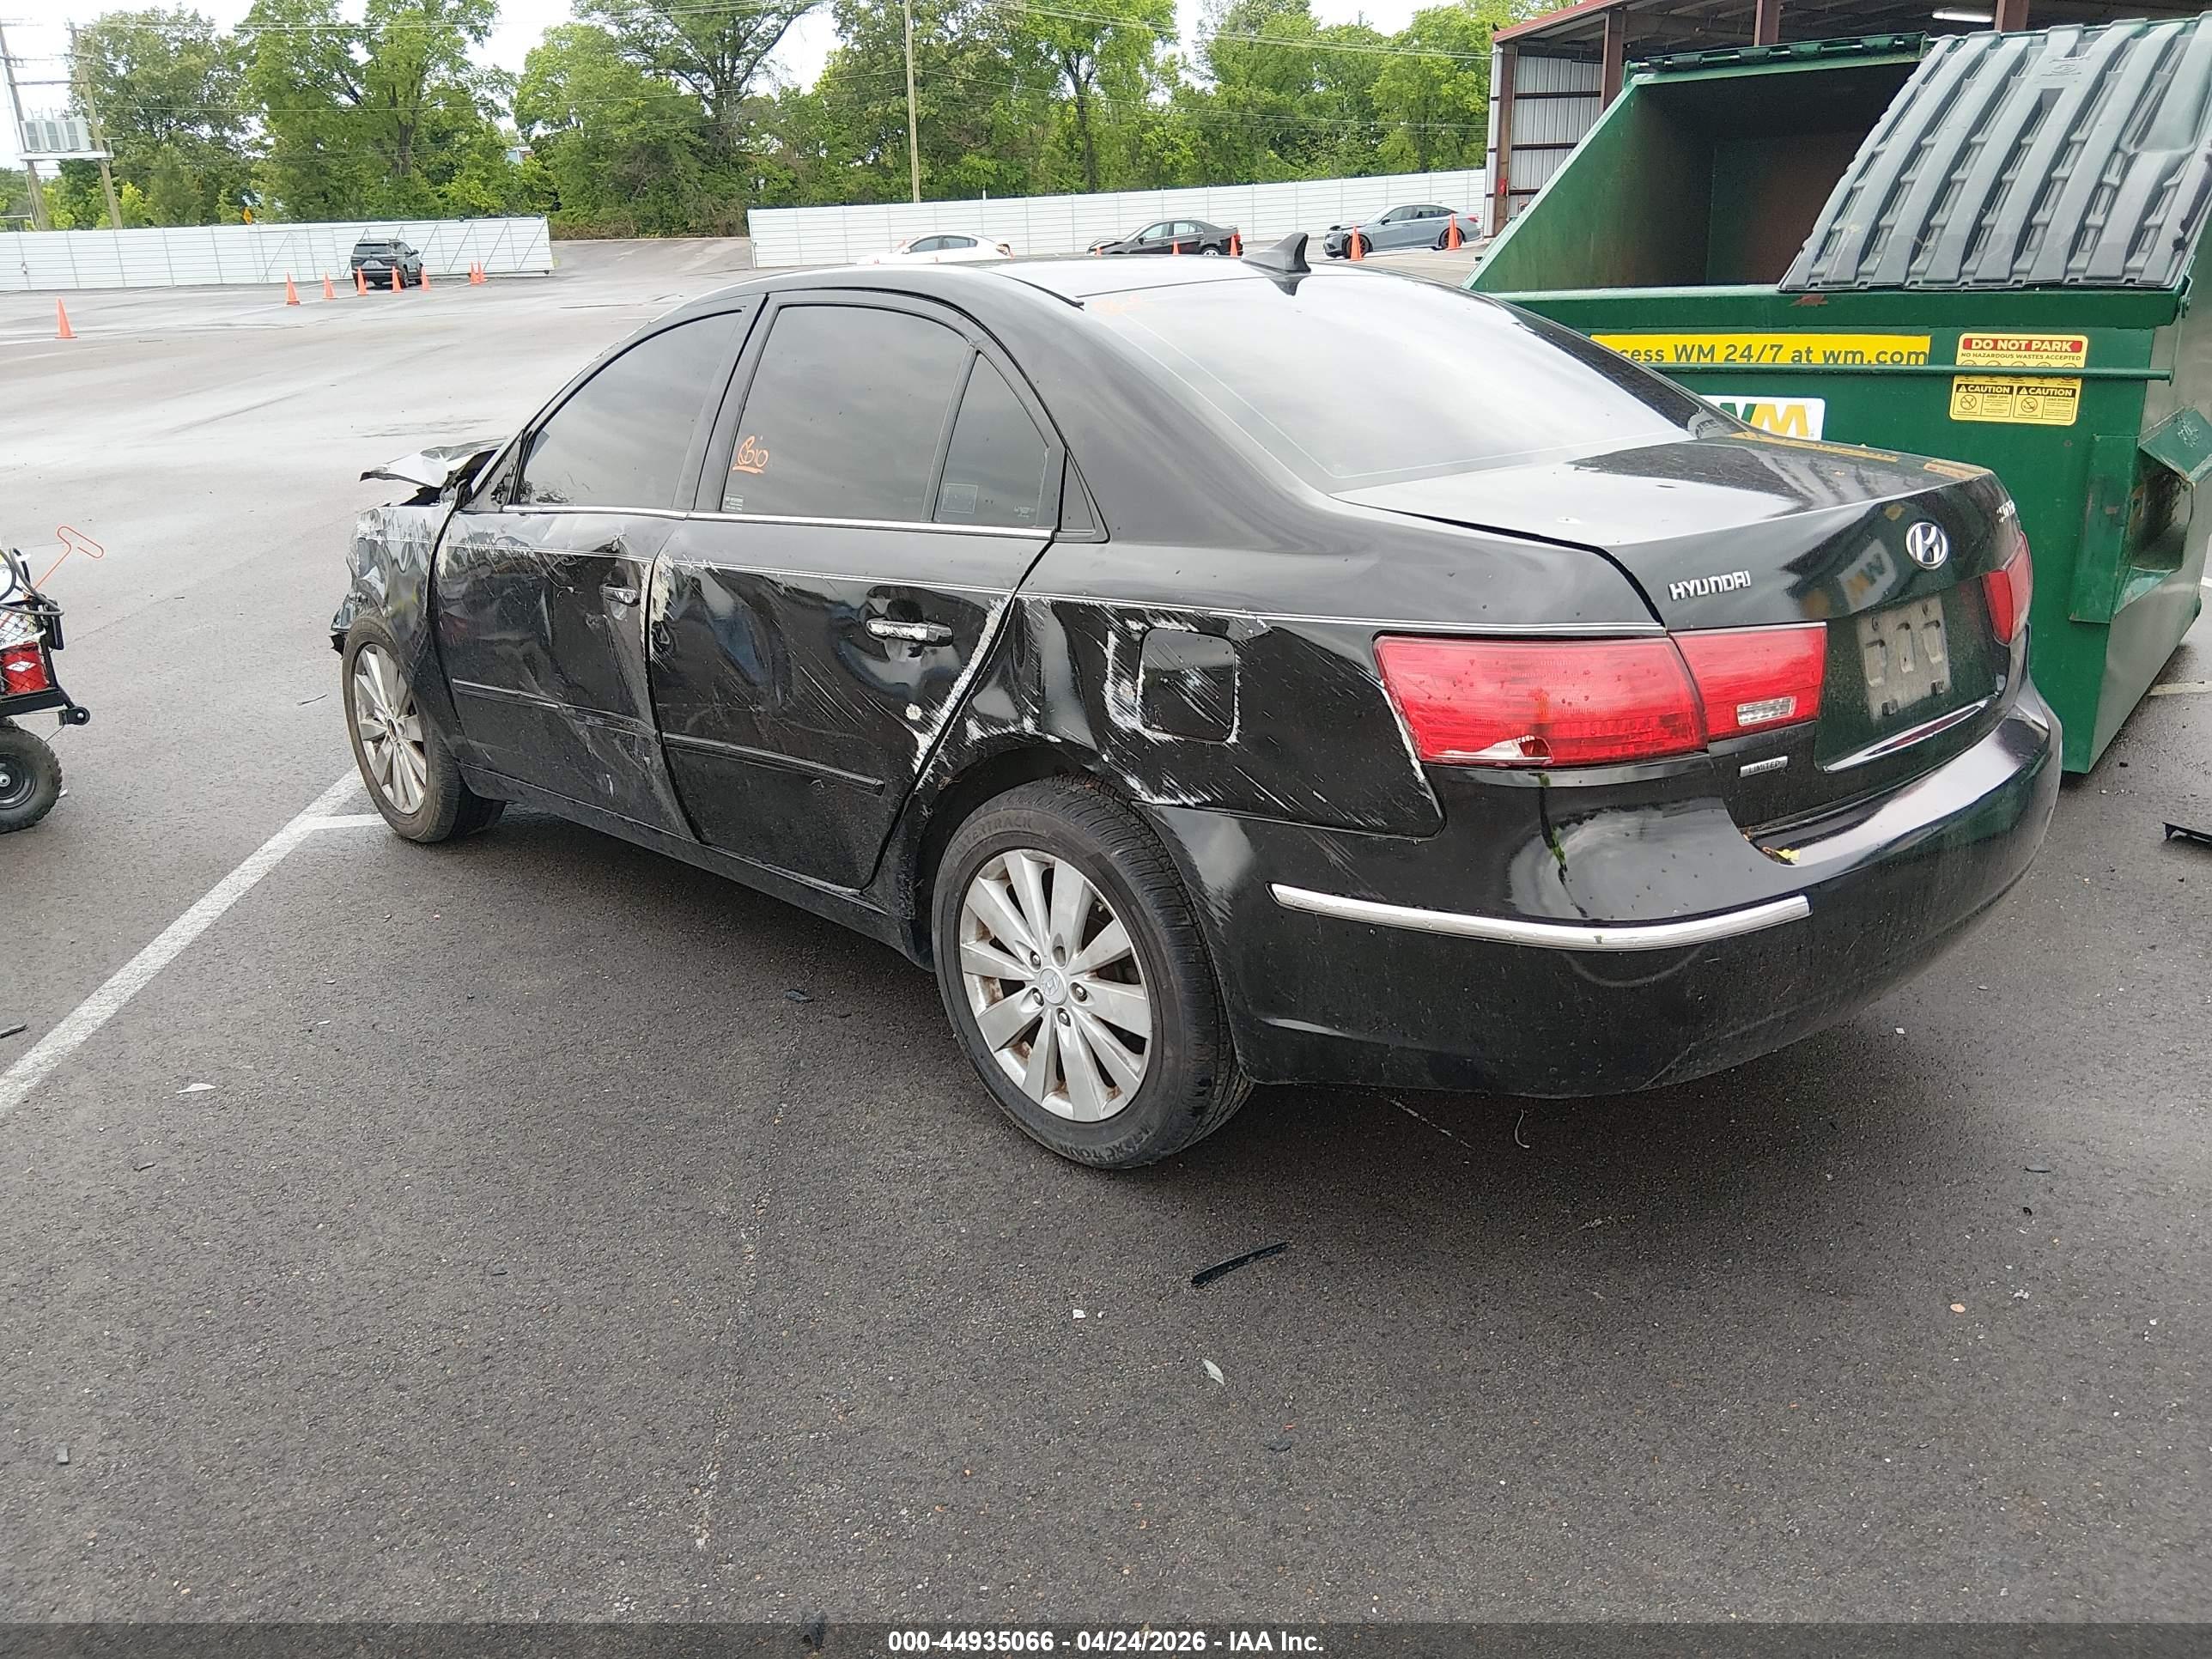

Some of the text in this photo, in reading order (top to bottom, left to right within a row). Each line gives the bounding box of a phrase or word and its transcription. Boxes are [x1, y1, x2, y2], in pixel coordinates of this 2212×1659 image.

[1971, 338, 2075, 352] DO NOT PARK
[1674, 343, 1715, 362] WM
[1724, 343, 1784, 363] 24/7
[1790, 345, 1814, 364] at
[1821, 349, 1928, 365] wm.com
[1967, 385, 2011, 394] CAUTION
[2028, 386, 2073, 397] CAUTION
[1668, 569, 1752, 601] HYUNDAI
[1748, 760, 1781, 774] LIMITED
